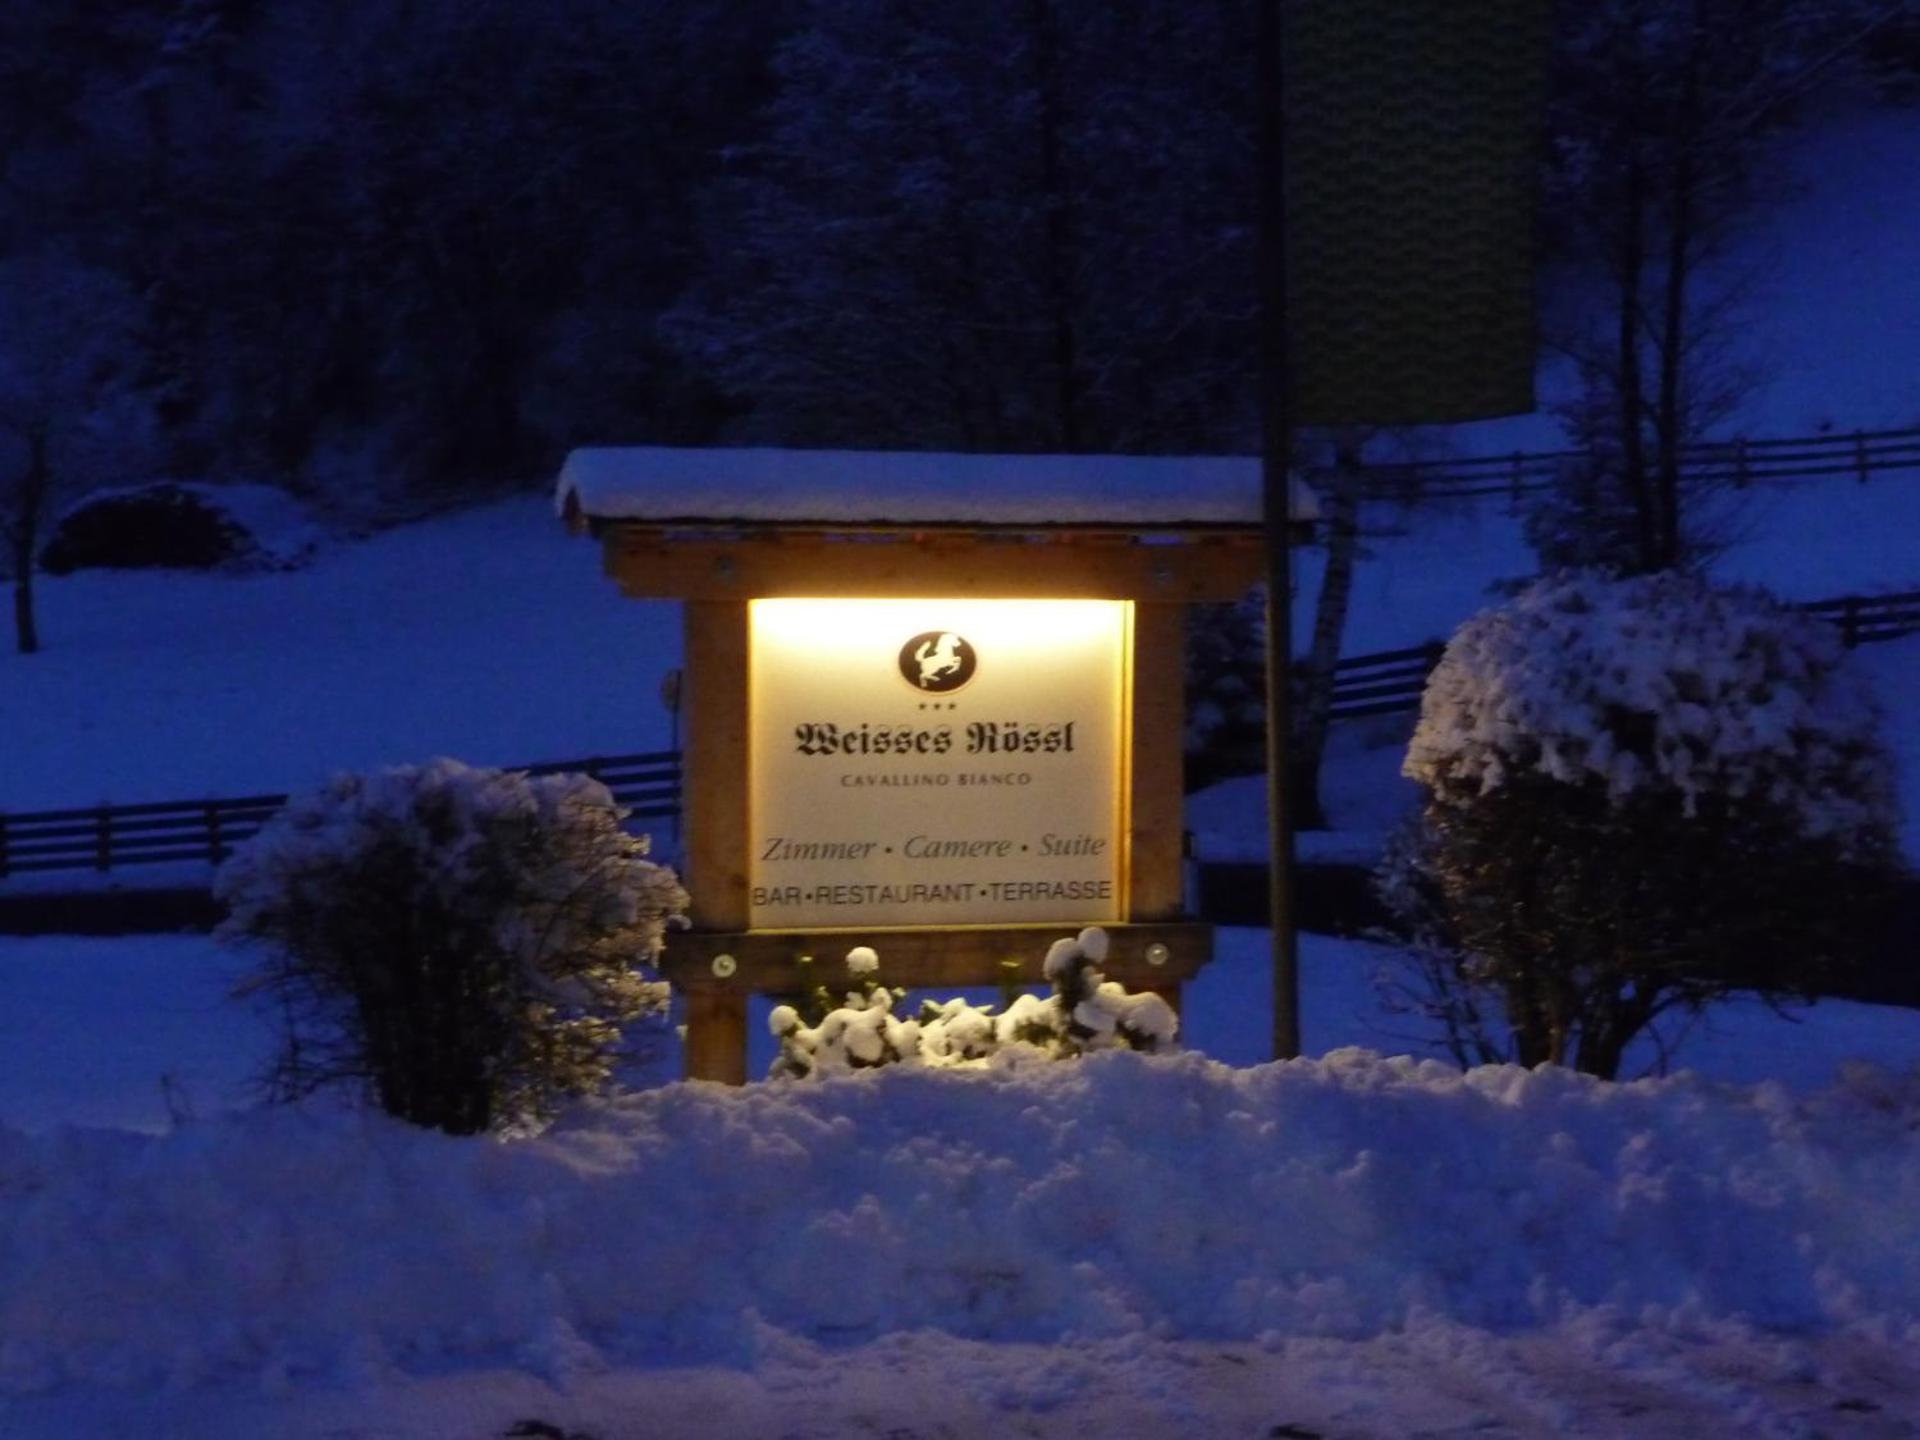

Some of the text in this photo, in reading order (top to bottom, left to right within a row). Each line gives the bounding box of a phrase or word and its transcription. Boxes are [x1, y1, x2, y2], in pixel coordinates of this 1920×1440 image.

[795, 720, 1076, 756] Weisses Rössl
[841, 772, 1032, 788] CAVALLINO BIANCO
[761, 832, 1106, 862] Zimmer Camere Suite
